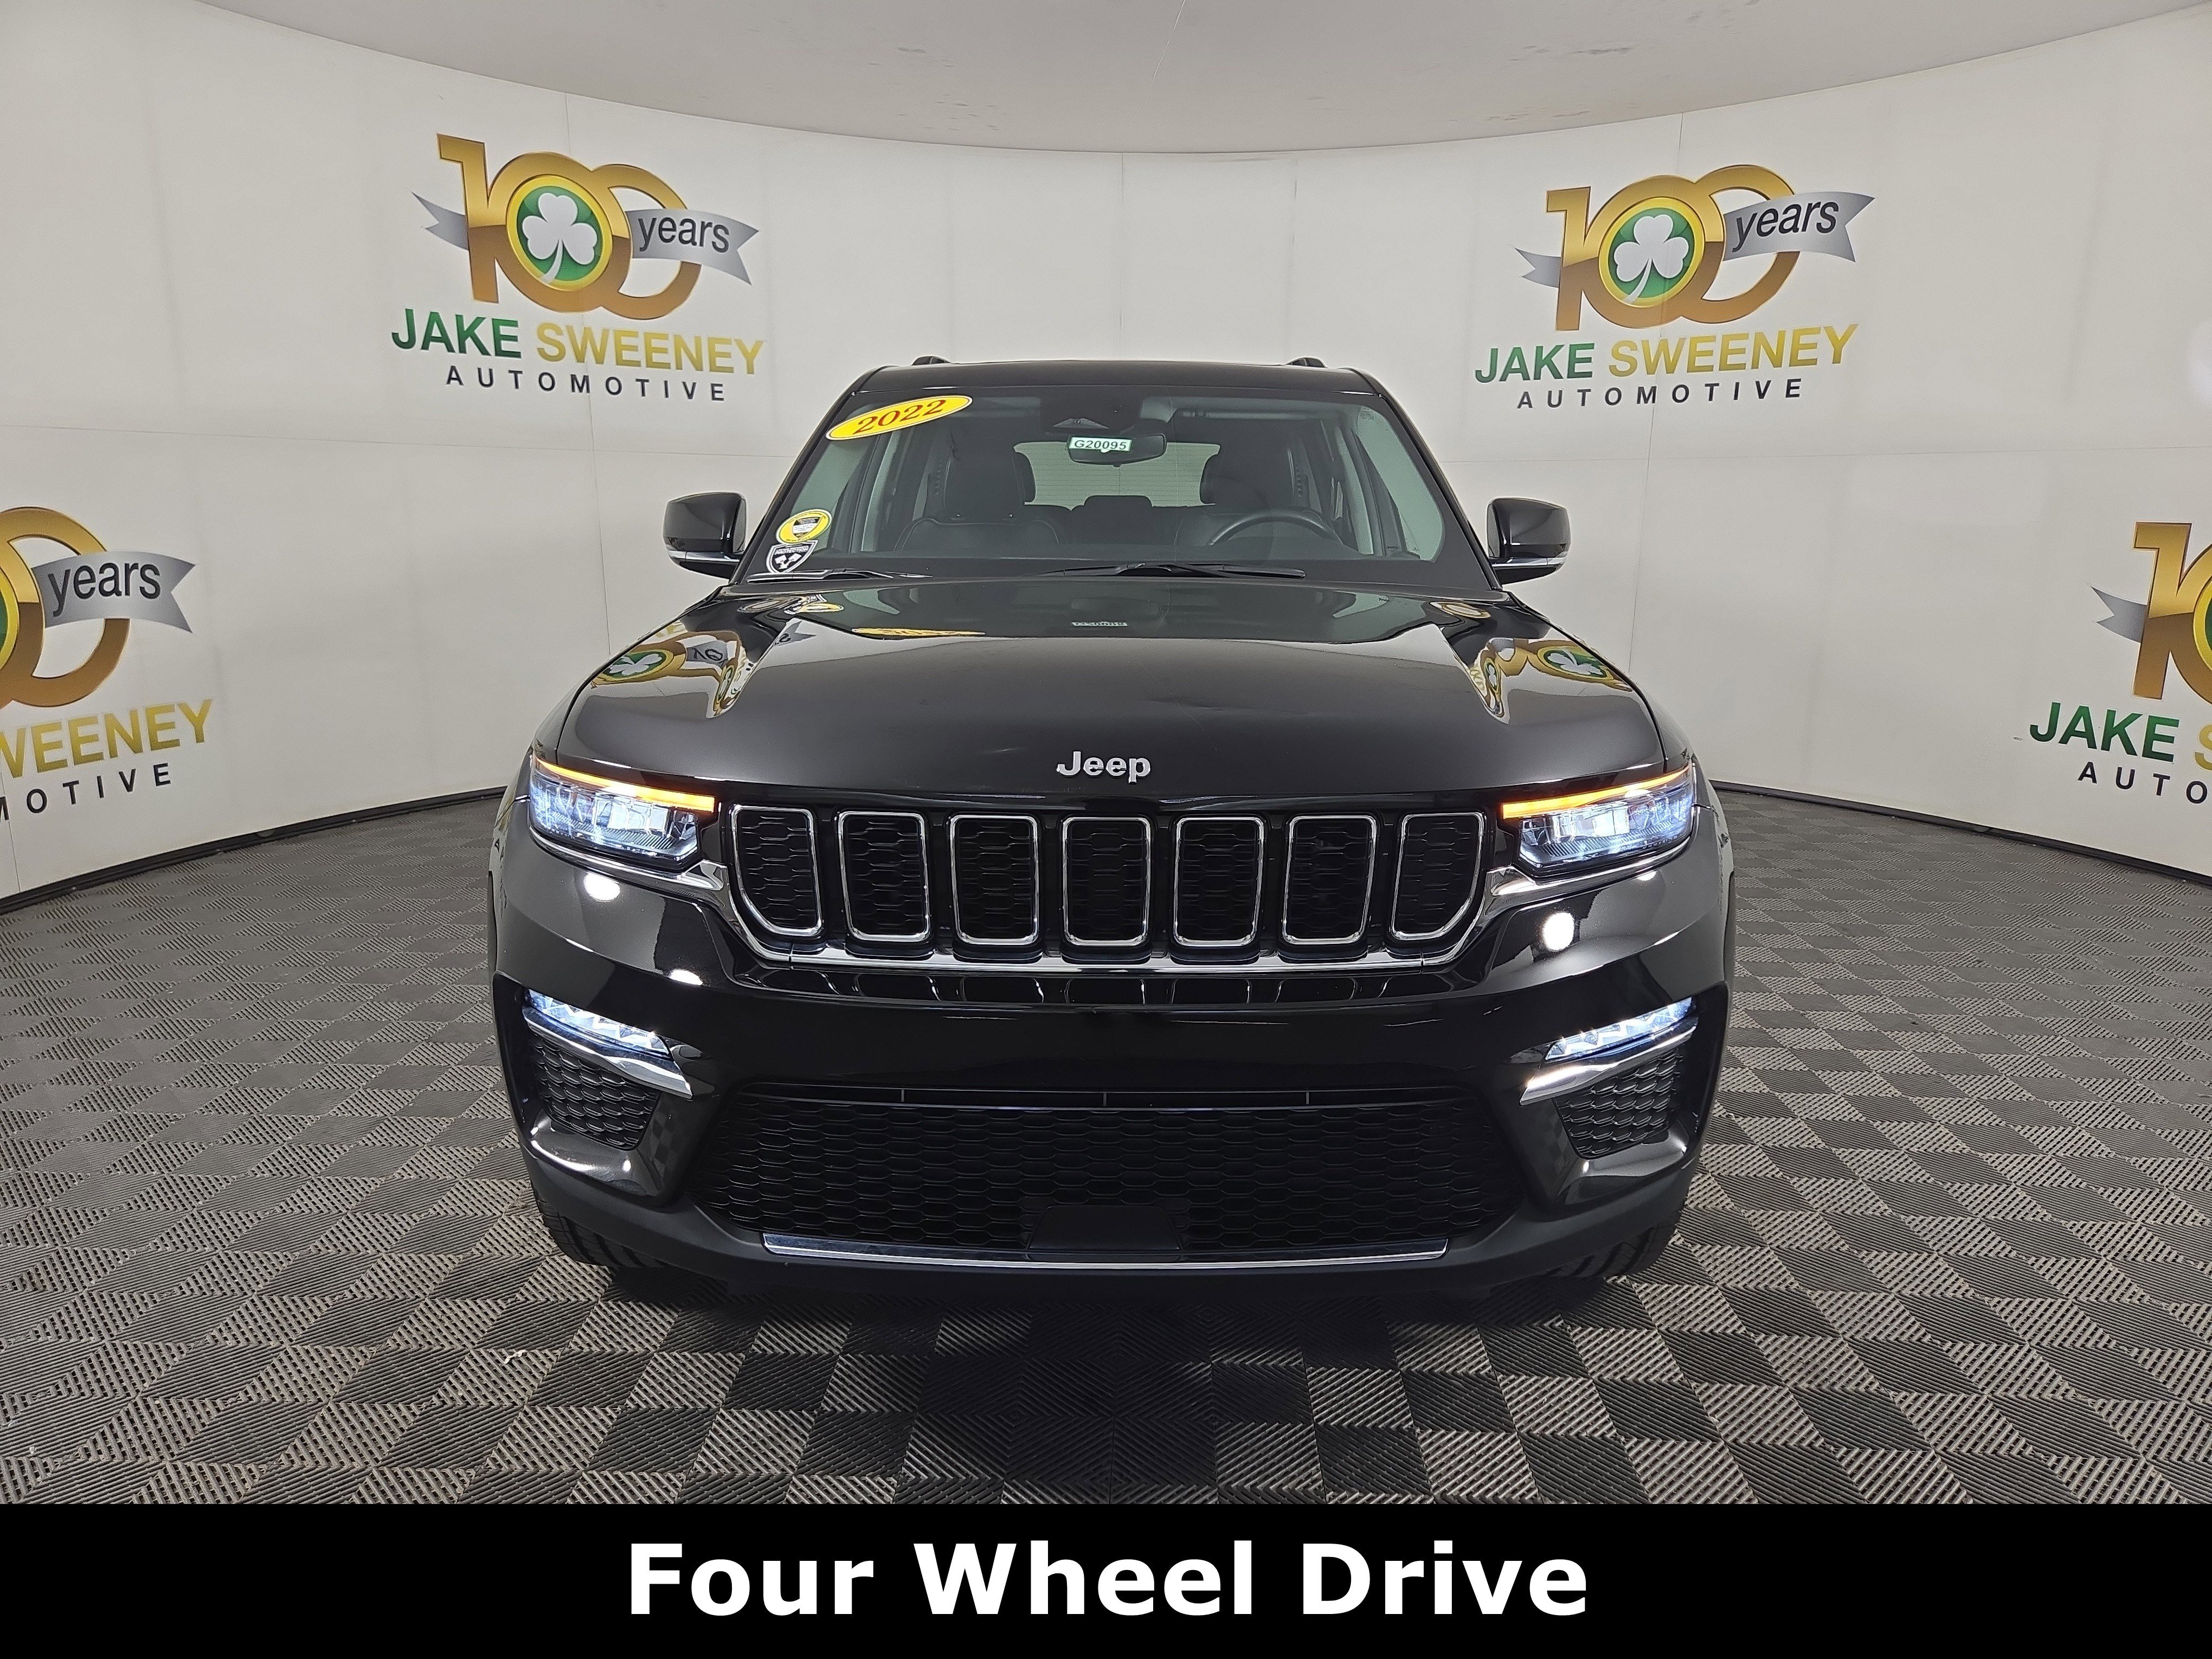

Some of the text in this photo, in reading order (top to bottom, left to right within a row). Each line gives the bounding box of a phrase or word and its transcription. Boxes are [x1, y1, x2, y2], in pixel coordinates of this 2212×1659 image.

[638, 216, 730, 253] years
[1732, 200, 1839, 253] years
[391, 308, 764, 375] JAKE SWEENEY
[1475, 324, 1859, 383] JAKE SWEENEY
[446, 365, 725, 401] AUTOMOTIVE
[1516, 378, 1802, 409] AUTOMOTIVE
[852, 400, 947, 435] 2022
[1073, 439, 1128, 451] G20095
[48, 561, 162, 616] years
[2029, 702, 2180, 763] JAKE
[1057, 751, 1151, 783] Jeep
[2078, 761, 2208, 804] AUTO
